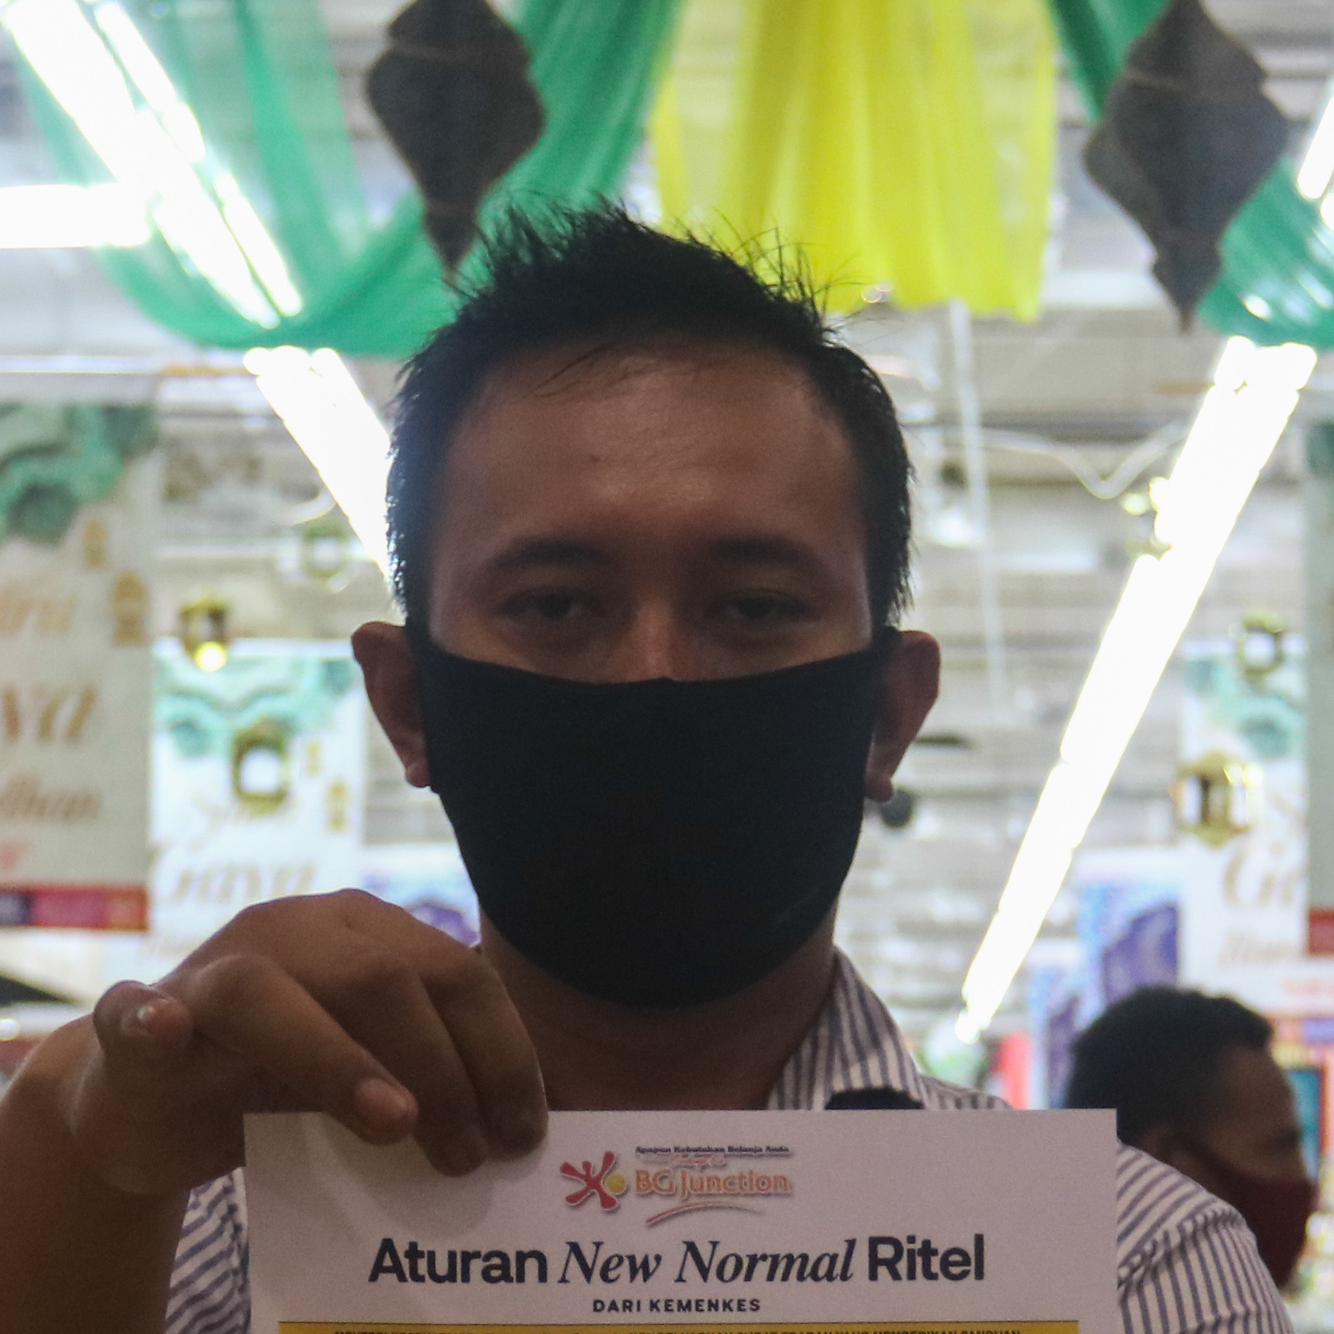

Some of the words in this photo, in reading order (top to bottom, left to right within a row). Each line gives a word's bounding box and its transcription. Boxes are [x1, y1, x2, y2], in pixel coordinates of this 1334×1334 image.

[635, 1170, 675, 1193] BG
[680, 1169, 789, 1199] Junction
[368, 1238, 547, 1283] Aturan
[558, 1241, 662, 1284] New
[675, 1239, 856, 1284] Normal
[868, 1233, 985, 1282] Ritel
[593, 1299, 640, 1312] DARI
[649, 1298, 761, 1312] KEMENKES
